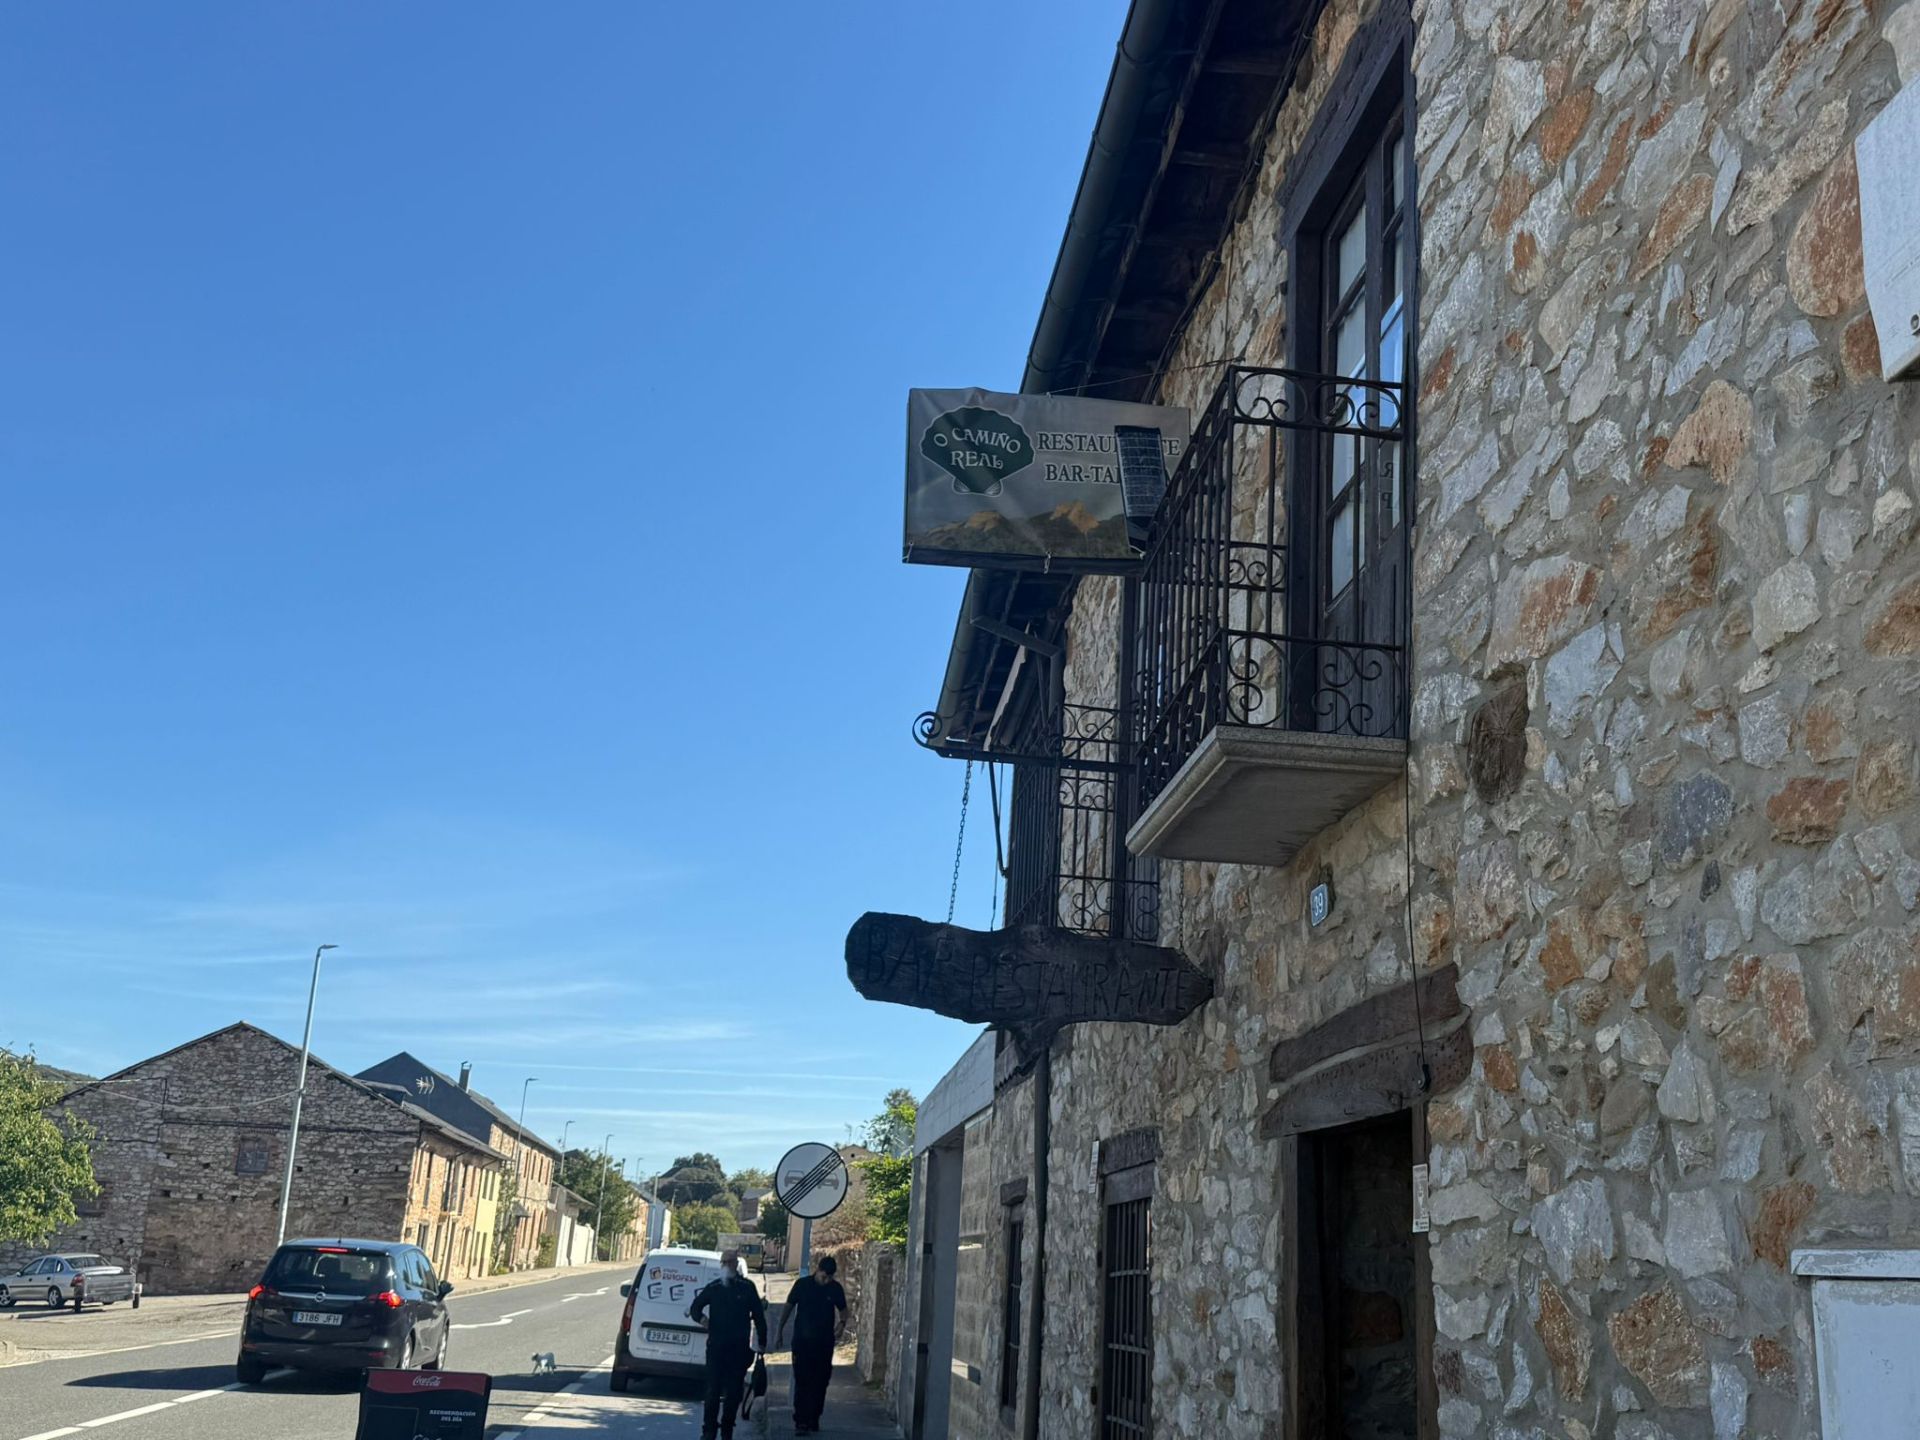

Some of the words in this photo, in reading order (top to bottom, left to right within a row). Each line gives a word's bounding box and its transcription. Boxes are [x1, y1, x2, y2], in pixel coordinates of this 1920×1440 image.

[933, 432, 949, 449] O
[1037, 432, 1181, 456] RESTAUE
[950, 450, 1004, 470] REAL
[1045, 463, 1121, 484] BAR-TA
[299, 1311, 320, 1322] 3186
[323, 1313, 340, 1325] JFH
